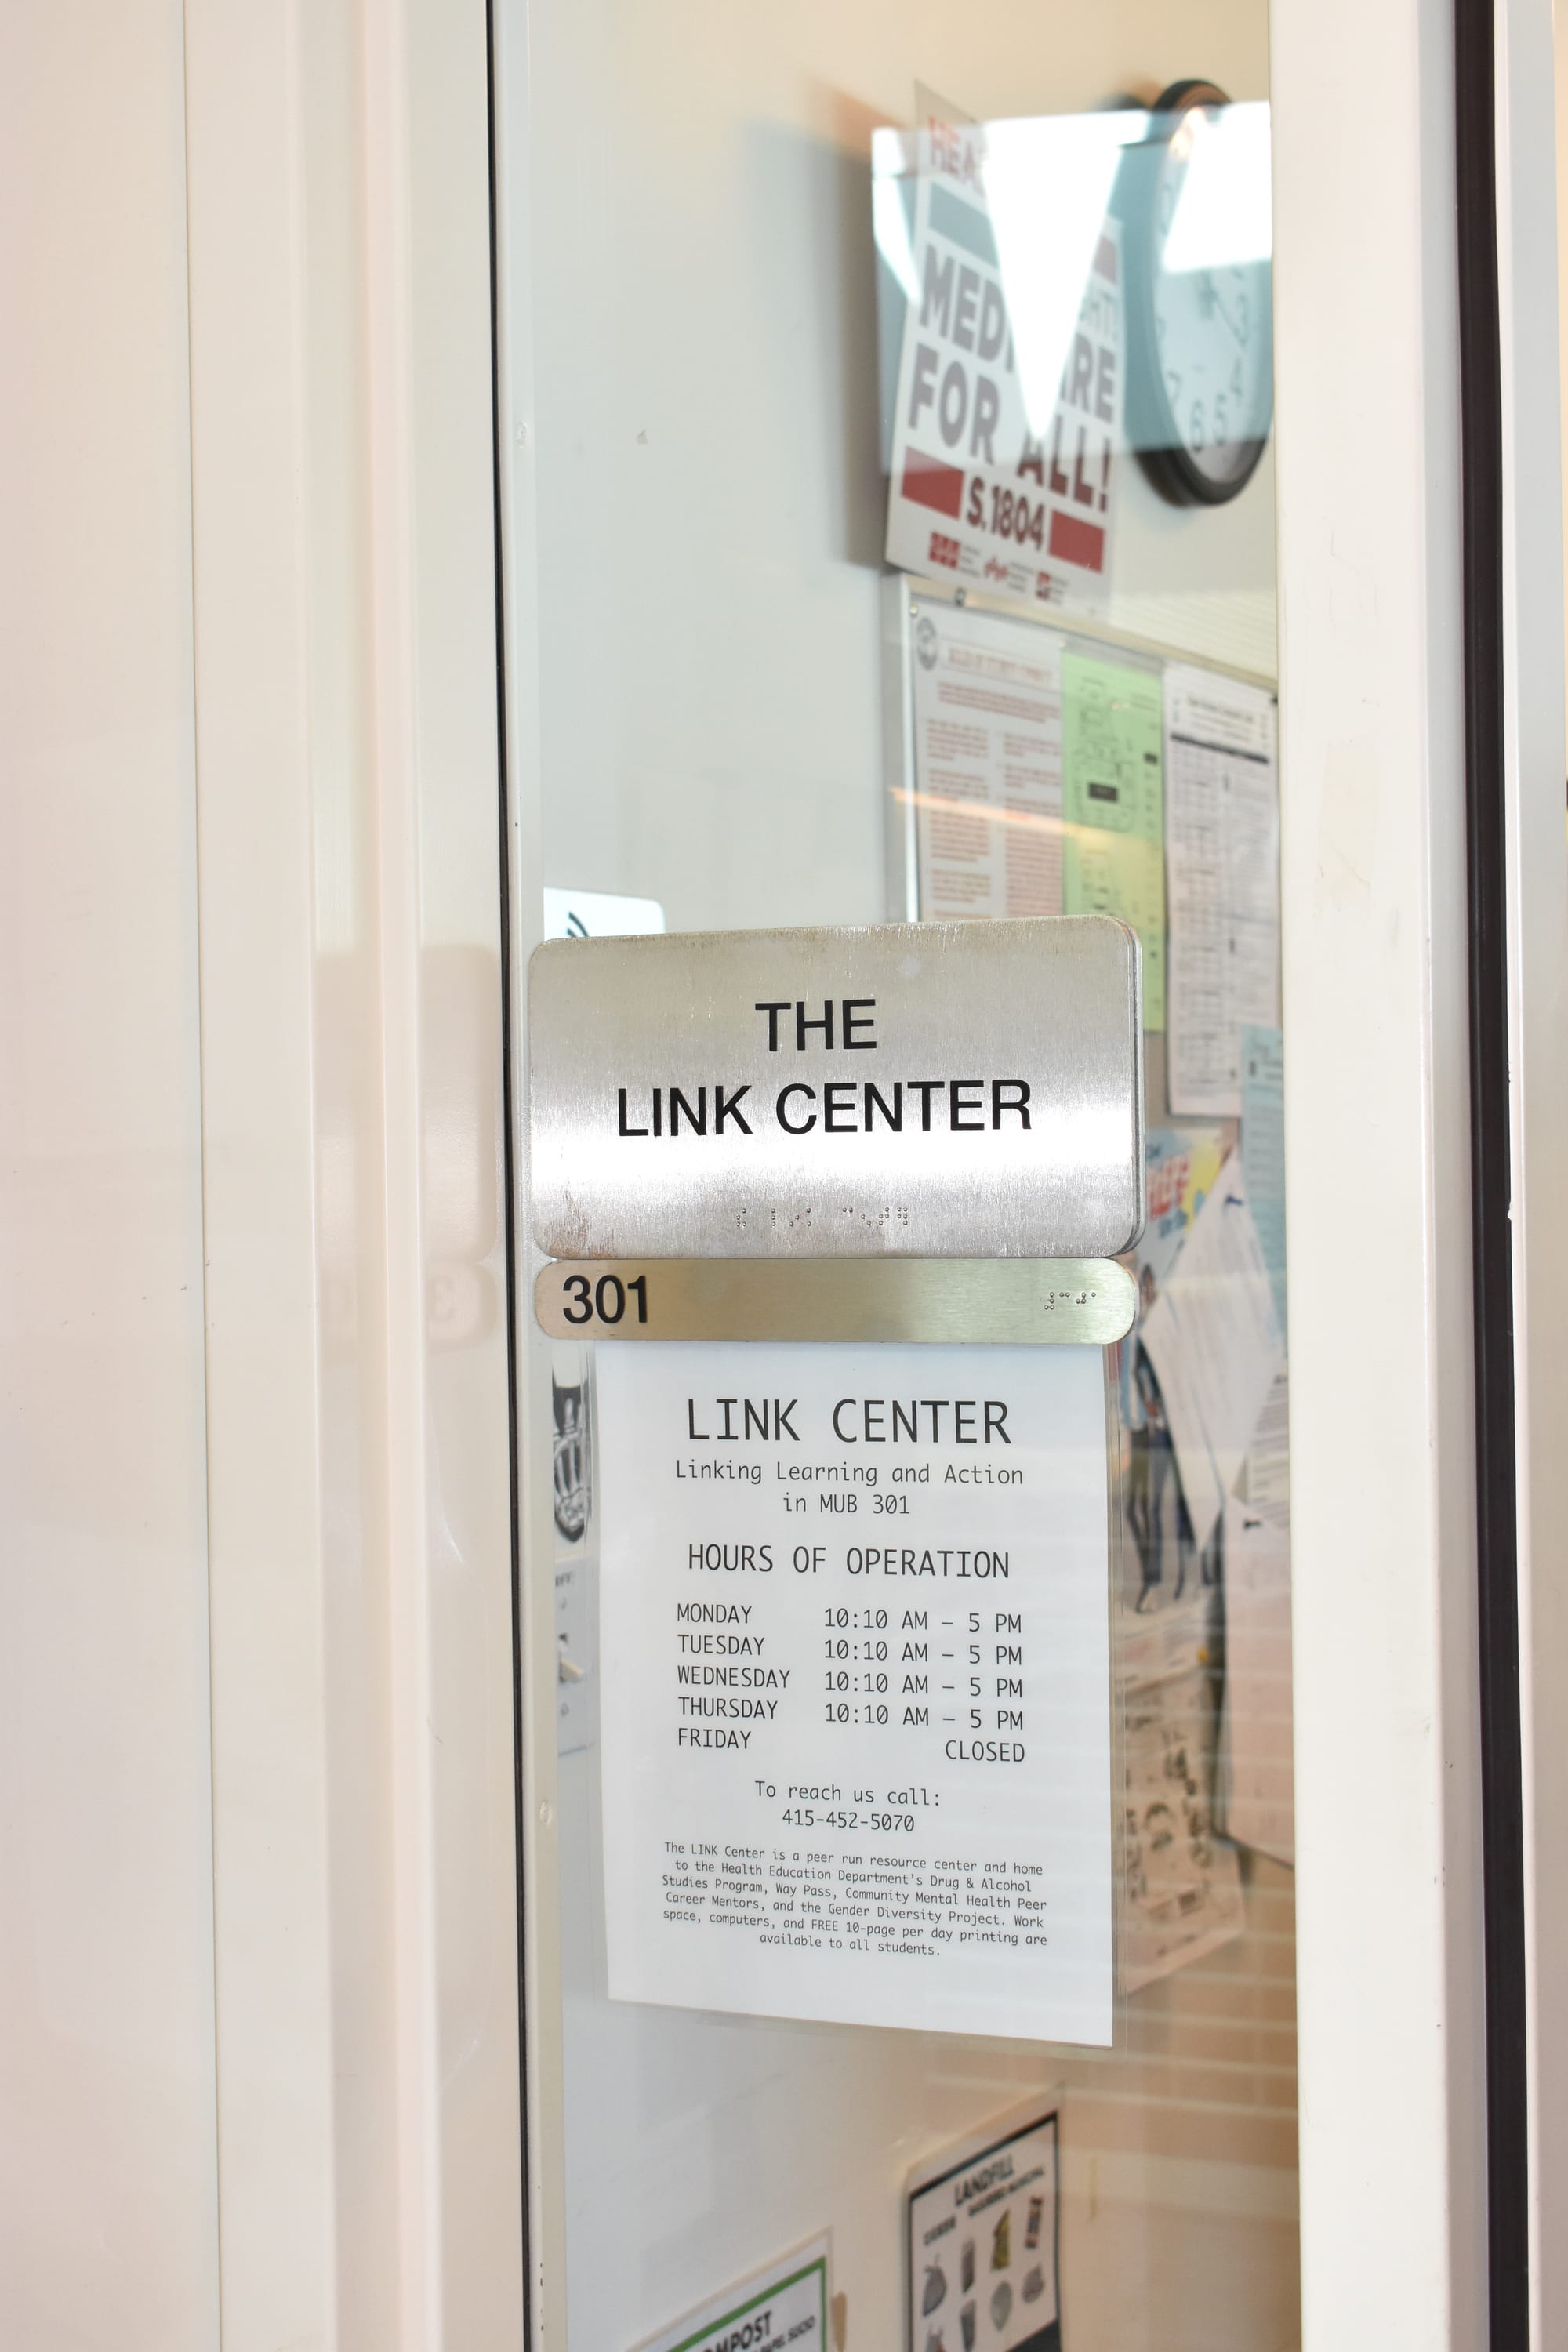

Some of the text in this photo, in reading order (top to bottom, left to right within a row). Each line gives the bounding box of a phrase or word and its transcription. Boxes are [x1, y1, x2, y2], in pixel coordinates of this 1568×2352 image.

[908, 341, 1112, 514] FOR ALL!
[967, 476, 1044, 550] S.1804
[755, 999, 877, 1051] THE
[618, 1079, 1032, 1138] LINK CENTER
[563, 1275, 647, 1323] 301
[688, 1399, 1012, 1444] LINK CENTER
[677, 1459, 1022, 1486] Linking Learning and Action
[783, 1492, 909, 1514] in MUB 301
[689, 1544, 1008, 1578] HOURS OF OPERATION
[677, 1603, 752, 1624] MONDAY
[825, 1608, 888, 1629] 10:10
[902, 1610, 928, 1630] AM
[969, 1613, 980, 1632] 5
[996, 1613, 1021, 1633] PM
[677, 1634, 764, 1656] TUESDAY
[825, 1639, 888, 1661] 10:10
[902, 1642, 928, 1662] AM
[970, 1645, 980, 1664] 5
[996, 1646, 1022, 1665] PM
[677, 1665, 790, 1688] WEDNESDAY
[826, 1671, 888, 1693] 10:10
[902, 1675, 928, 1694] AM
[970, 1677, 981, 1697] 5
[997, 1678, 1022, 1698] PM
[678, 1697, 778, 1719] THURSDAY
[826, 1703, 888, 1725] 10:10
[902, 1707, 929, 1726] AM
[971, 1708, 982, 1729] 5
[997, 1710, 1022, 1730] PM
[679, 1728, 1025, 1762] FRIDAY CLOSED
[755, 1780, 939, 1806] To reach us call:
[782, 1809, 914, 1831] 415-452-5070
[665, 1842, 1043, 1875] The LINK Center is a peer run resource center and home
[675, 1860, 688, 1871] to
[695, 1860, 714, 1872] the
[722, 1863, 762, 1875] Health
[770, 1865, 831, 1880] Education
[931, 1875, 959, 1890] Drug
[966, 1878, 975, 1889] &
[981, 1878, 1031, 1892] Alcohol
[662, 1875, 1047, 1911] Studies Program, Way Pass, Community Mental Health Peer
[666, 1892, 1043, 1928] Career Mentors, and the Gender Diversity Project. Work
[663, 1911, 1047, 1946] space, computers, and FREE 10-page per day printing are
[760, 1933, 939, 1955] available to all students.
